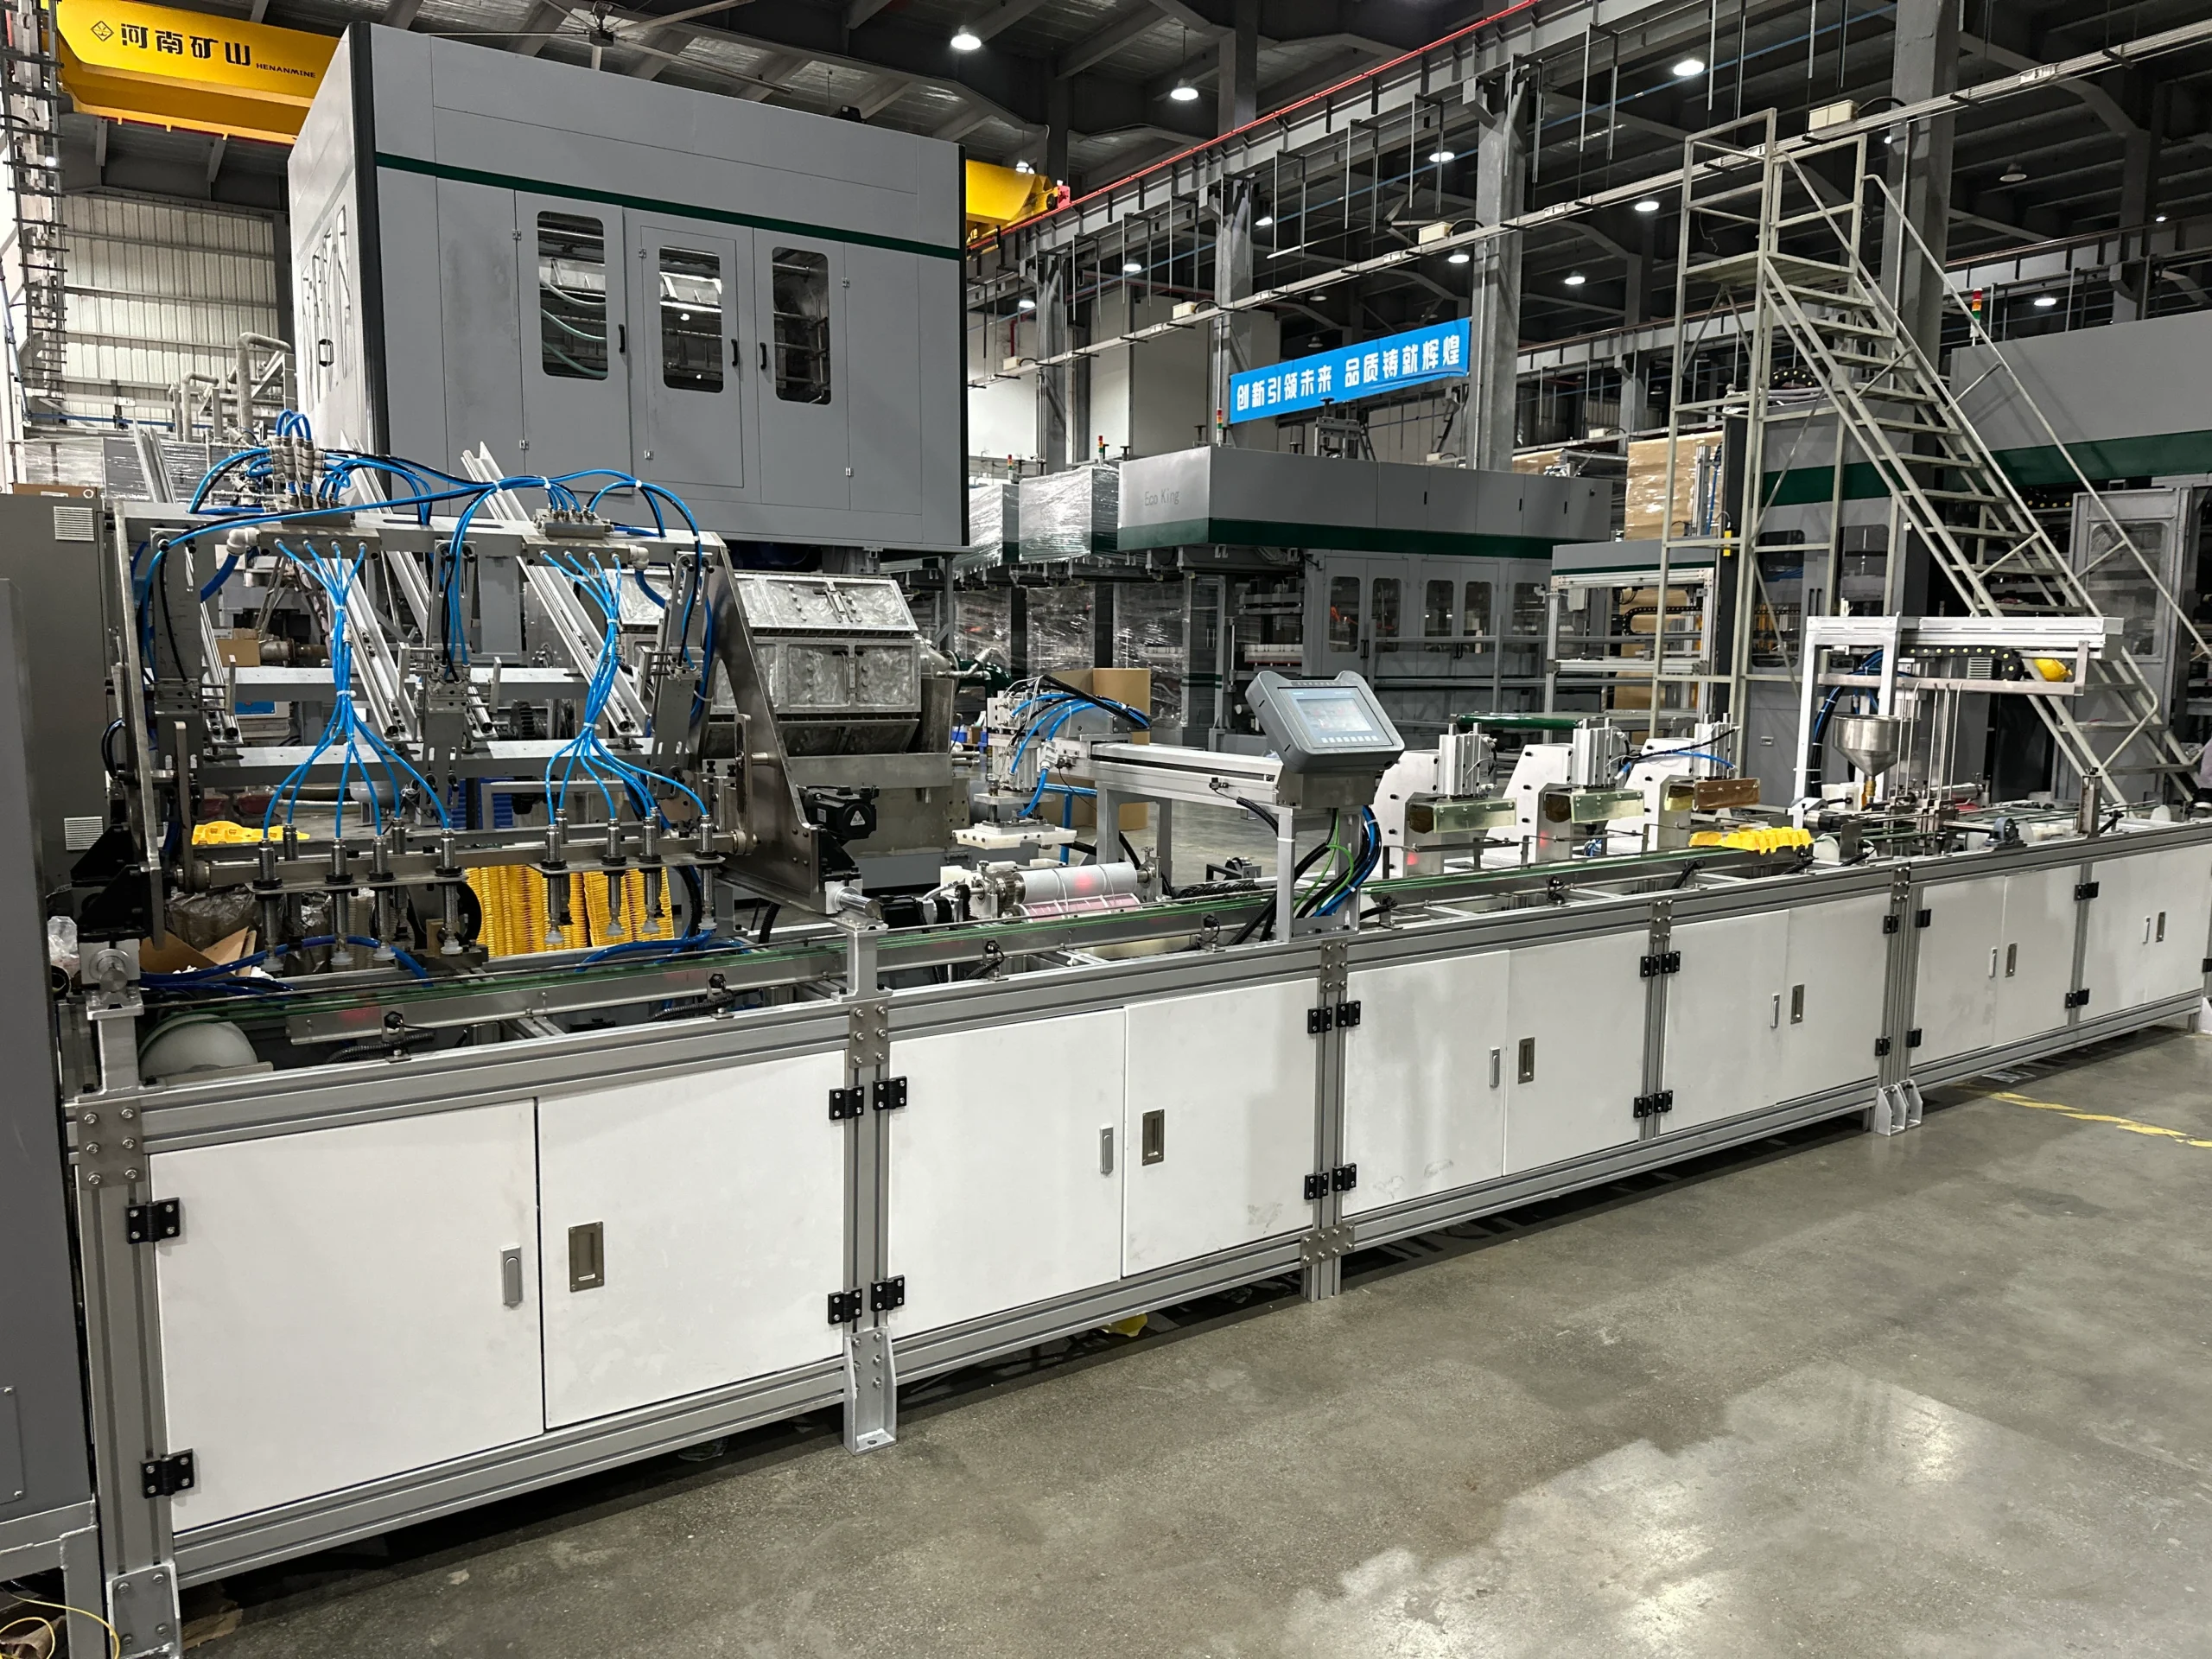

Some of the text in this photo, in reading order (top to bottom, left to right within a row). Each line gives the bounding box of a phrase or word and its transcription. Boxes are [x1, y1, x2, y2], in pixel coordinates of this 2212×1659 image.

[121, 23, 251, 66] 河南矿山
[256, 62, 316, 79] HENANMINE
[1236, 334, 1460, 411] 创新引领未来 品质铸就辉煌
[1144, 487, 1179, 506] Eco King
